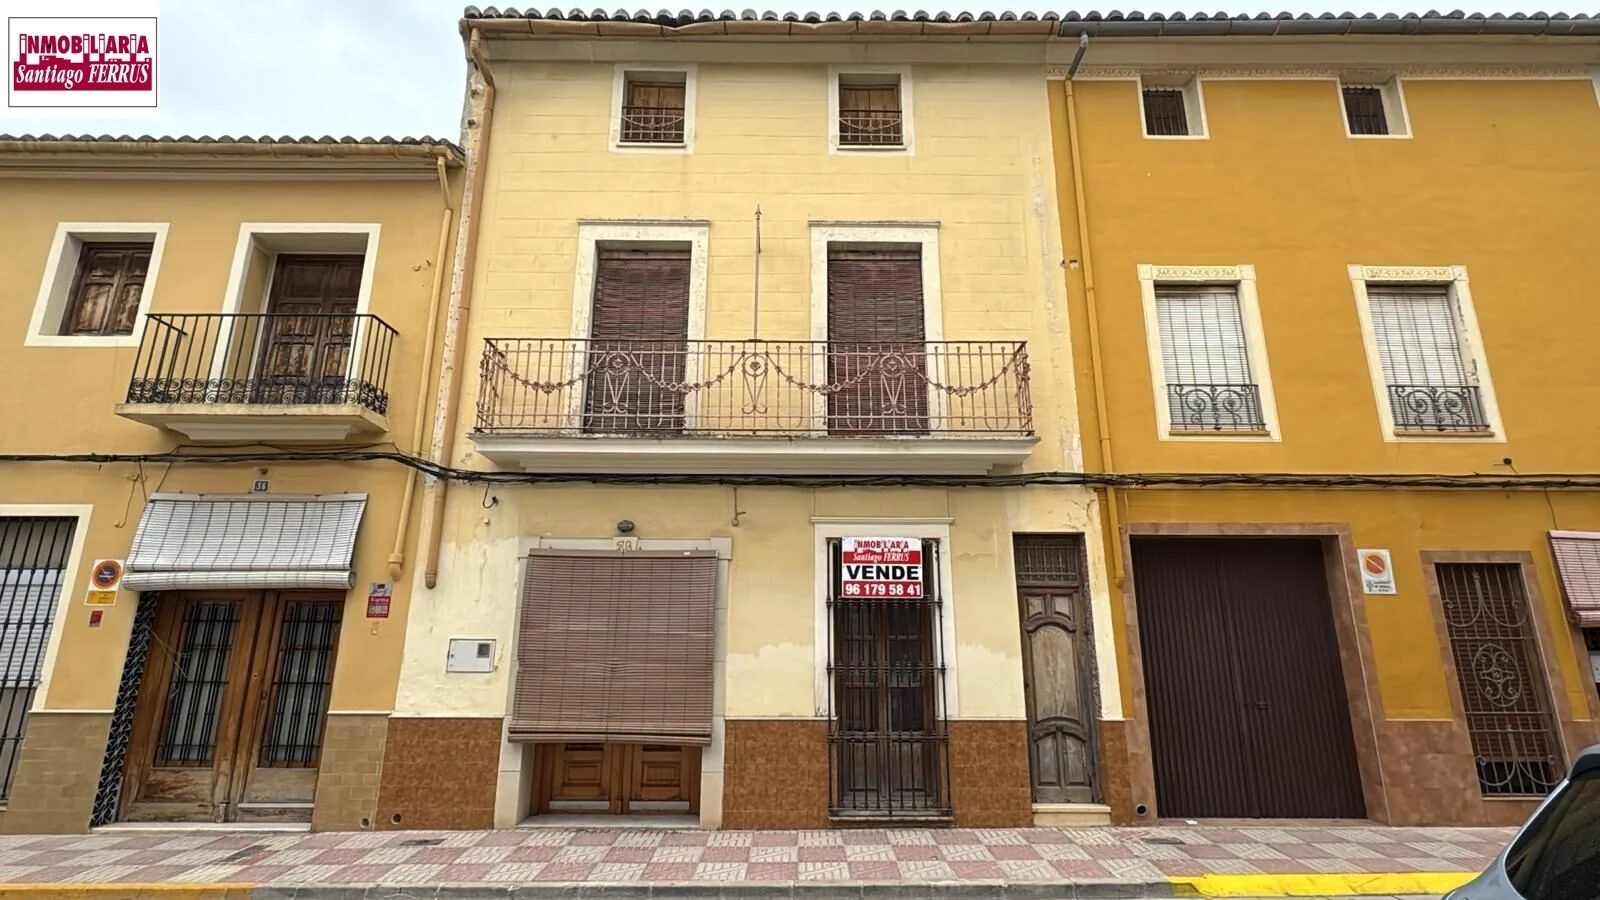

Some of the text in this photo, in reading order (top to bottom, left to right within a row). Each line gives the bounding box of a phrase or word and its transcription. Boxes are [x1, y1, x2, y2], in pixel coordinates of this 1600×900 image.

[853, 552, 910, 563] Santiago FERRUS
[846, 565, 919, 580] VENDE
[845, 583, 921, 596] 96 179 58 41
